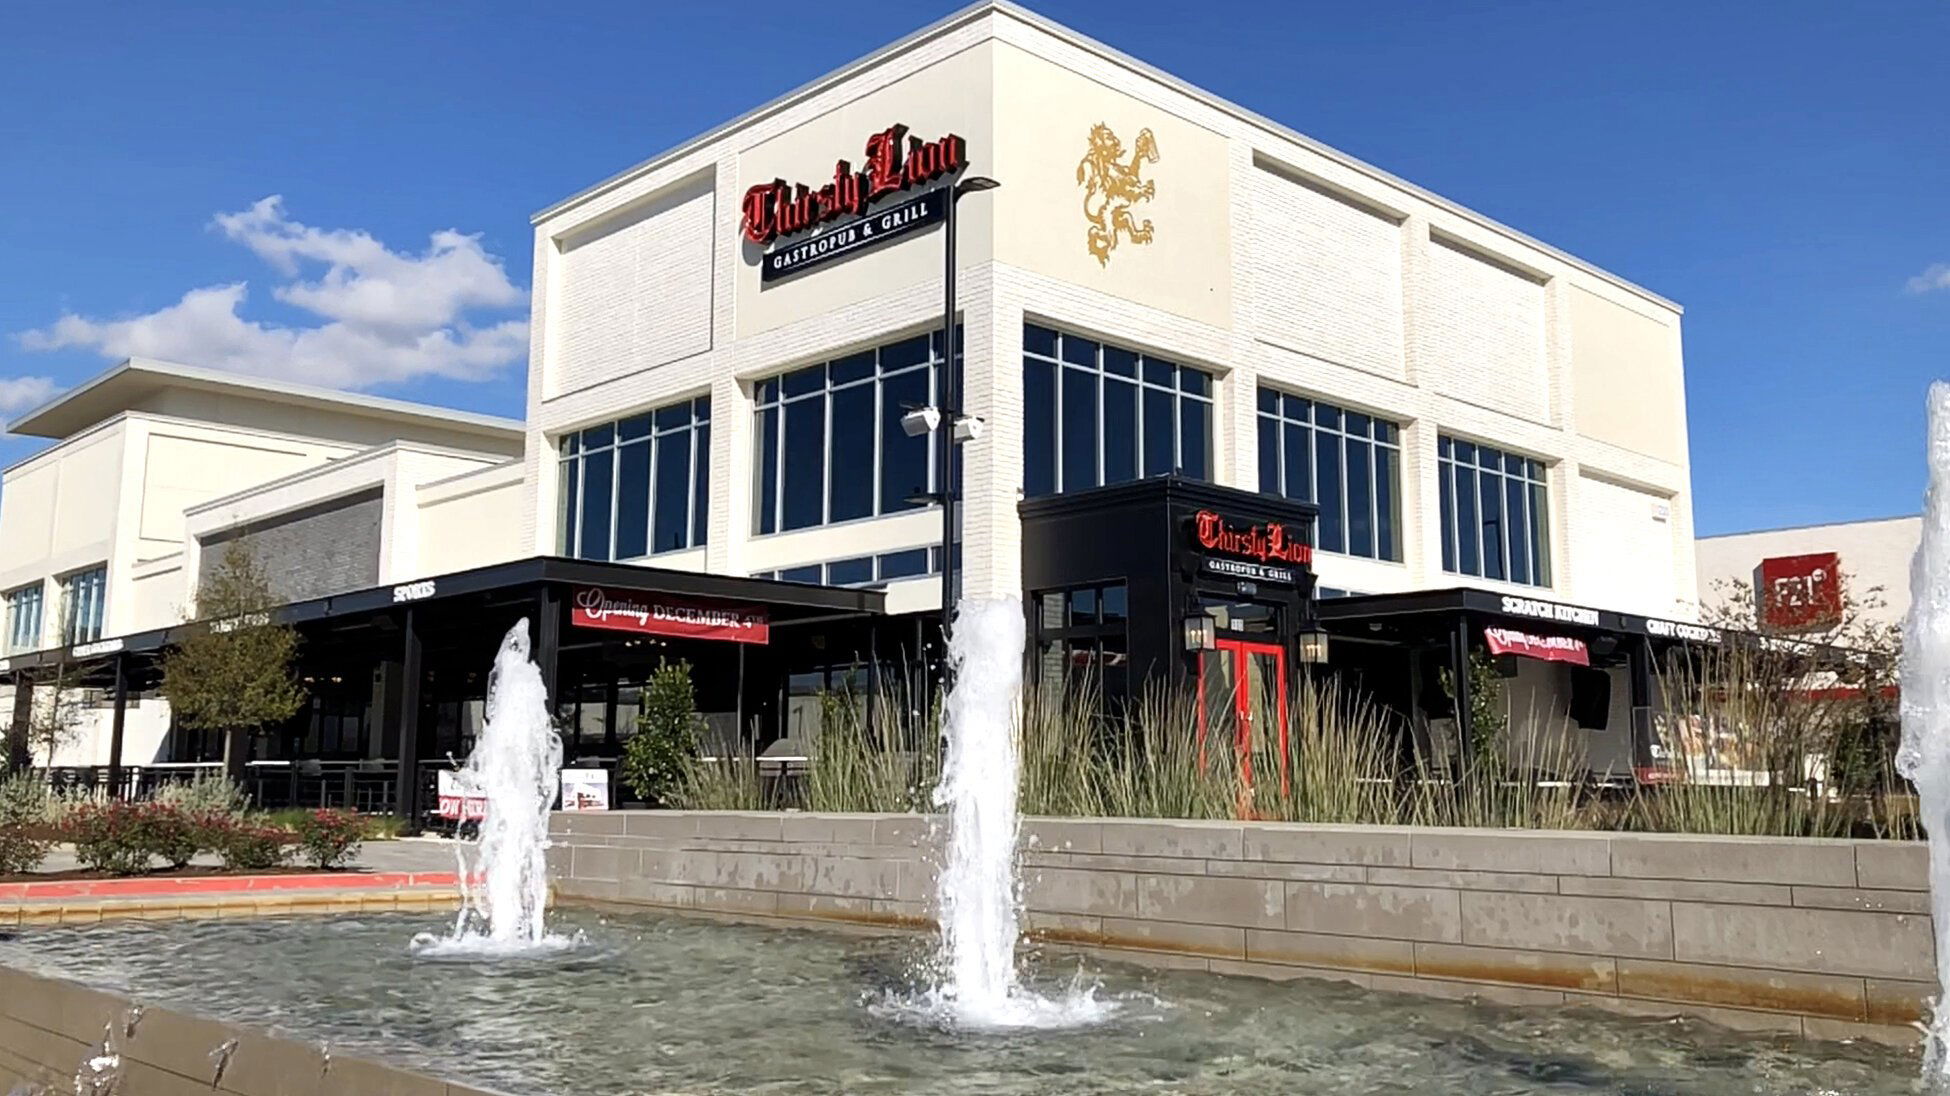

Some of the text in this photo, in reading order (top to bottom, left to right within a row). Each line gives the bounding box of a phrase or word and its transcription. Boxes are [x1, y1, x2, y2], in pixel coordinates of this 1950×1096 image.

[742, 124, 965, 244] Thirsty Lion
[773, 203, 928, 269] GASTROPUB & GRILL
[1196, 509, 1312, 563] Thirsty Lion
[393, 580, 435, 602] SPORTS
[1208, 560, 1257, 575] GASTROPUB
[1268, 570, 1292, 581] GRILL
[577, 588, 649, 627] Opening
[653, 604, 741, 629] DECEMBER
[1502, 596, 1599, 625] SCRATCH KITCHEN
